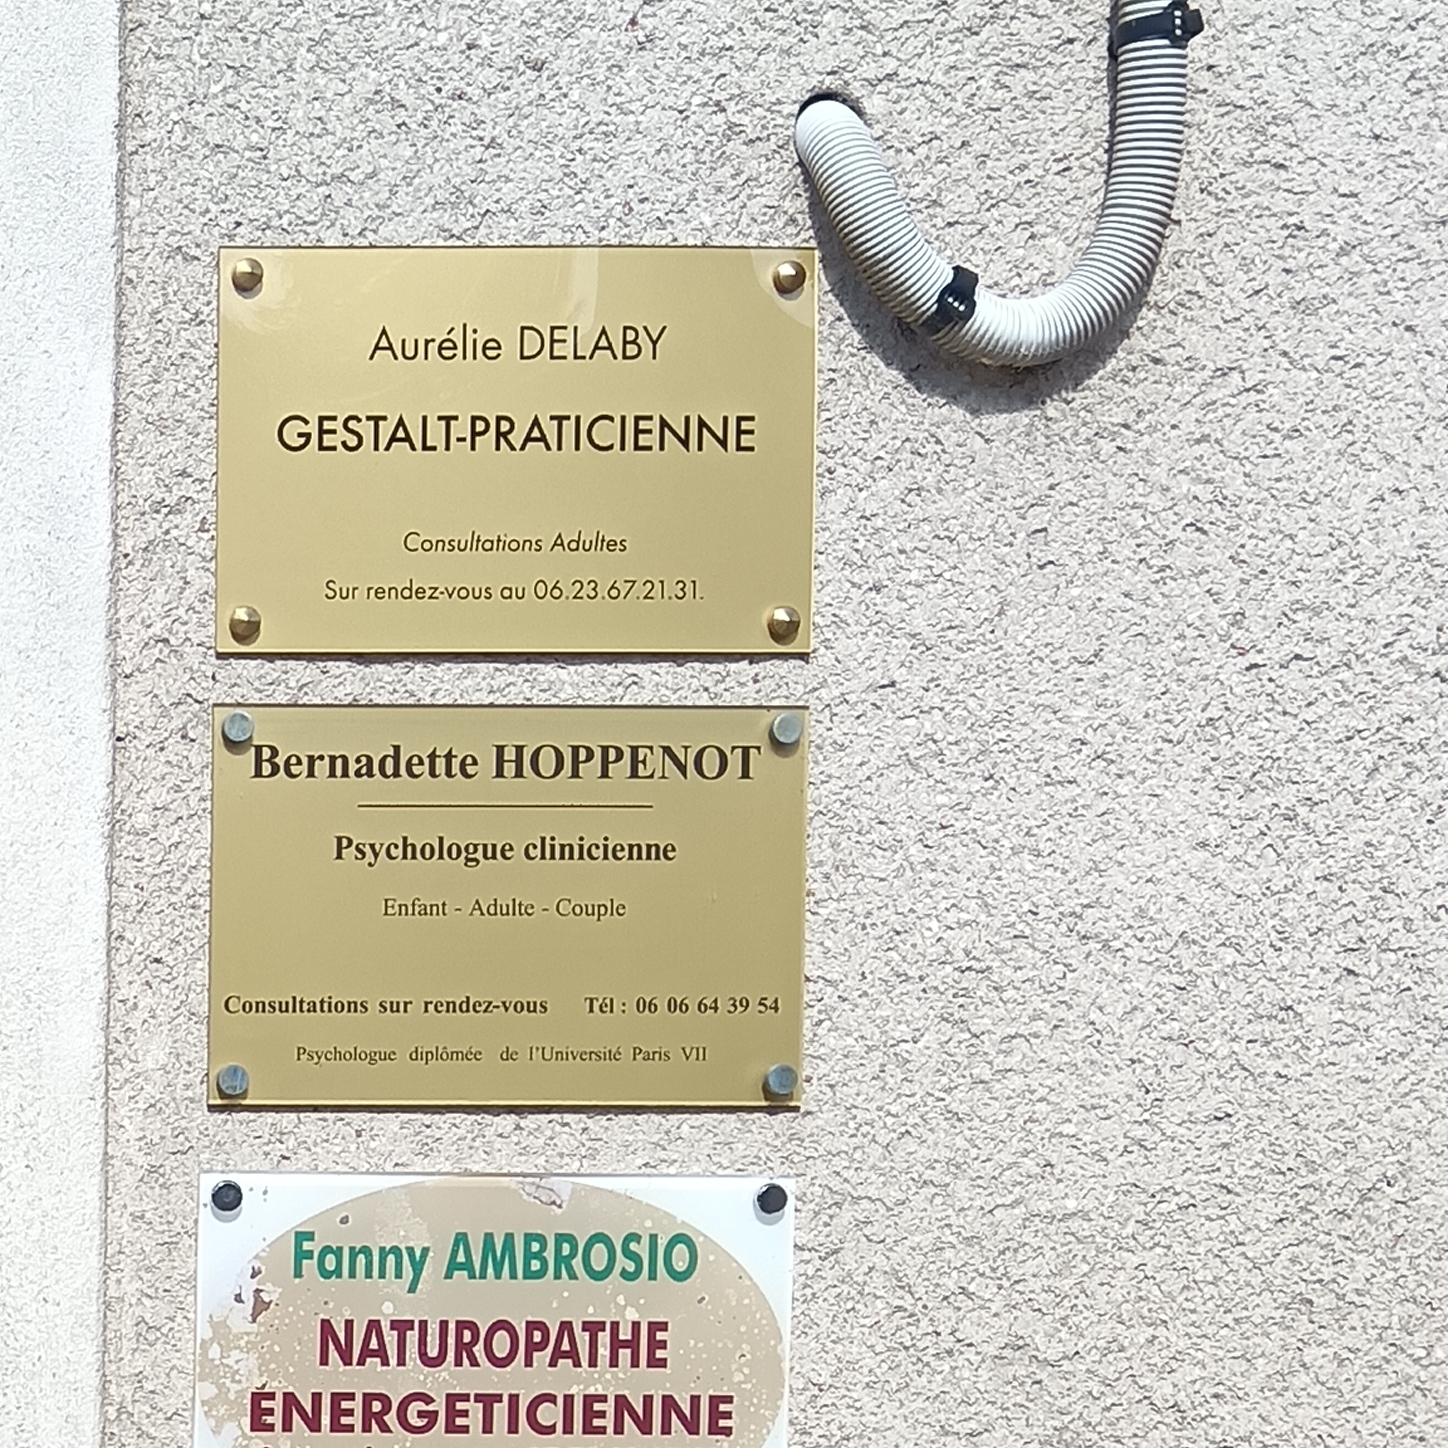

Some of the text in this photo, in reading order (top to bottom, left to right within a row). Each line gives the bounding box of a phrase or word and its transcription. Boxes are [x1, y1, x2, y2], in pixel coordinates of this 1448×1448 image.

[368, 322, 667, 361] Aurélie DELABY
[277, 413, 756, 453] GESTALT-PRATICIENNE
[403, 530, 627, 553] Consultations Adultes
[324, 578, 704, 601] Sur rendez-vous au 06.23.67.21.31.
[249, 743, 762, 781] Bernadette HOPPENOT
[334, 835, 677, 868] Psychologue clinicienne
[383, 897, 448, 917] Enfant
[468, 897, 535, 917] Adulte
[555, 898, 626, 922] Couple
[224, 995, 369, 1014] Consultations
[378, 1000, 413, 1014] sur
[423, 995, 548, 1014] rendez-vous
[584, 996, 614, 1014] Tél
[635, 996, 658, 1014] 06
[667, 996, 690, 1014] 06
[697, 996, 720, 1014] 64
[726, 996, 750, 1014] 39
[757, 996, 780, 1014] 54
[296, 1046, 397, 1066] Psychologue
[409, 1045, 483, 1066] diplômée
[499, 1046, 519, 1062] de
[632, 1046, 671, 1062] Paris
[681, 1046, 707, 1062] VII
[293, 1230, 698, 1294] Fanny AMBROSIO
[319, 1318, 669, 1369] NATUROPATHE
